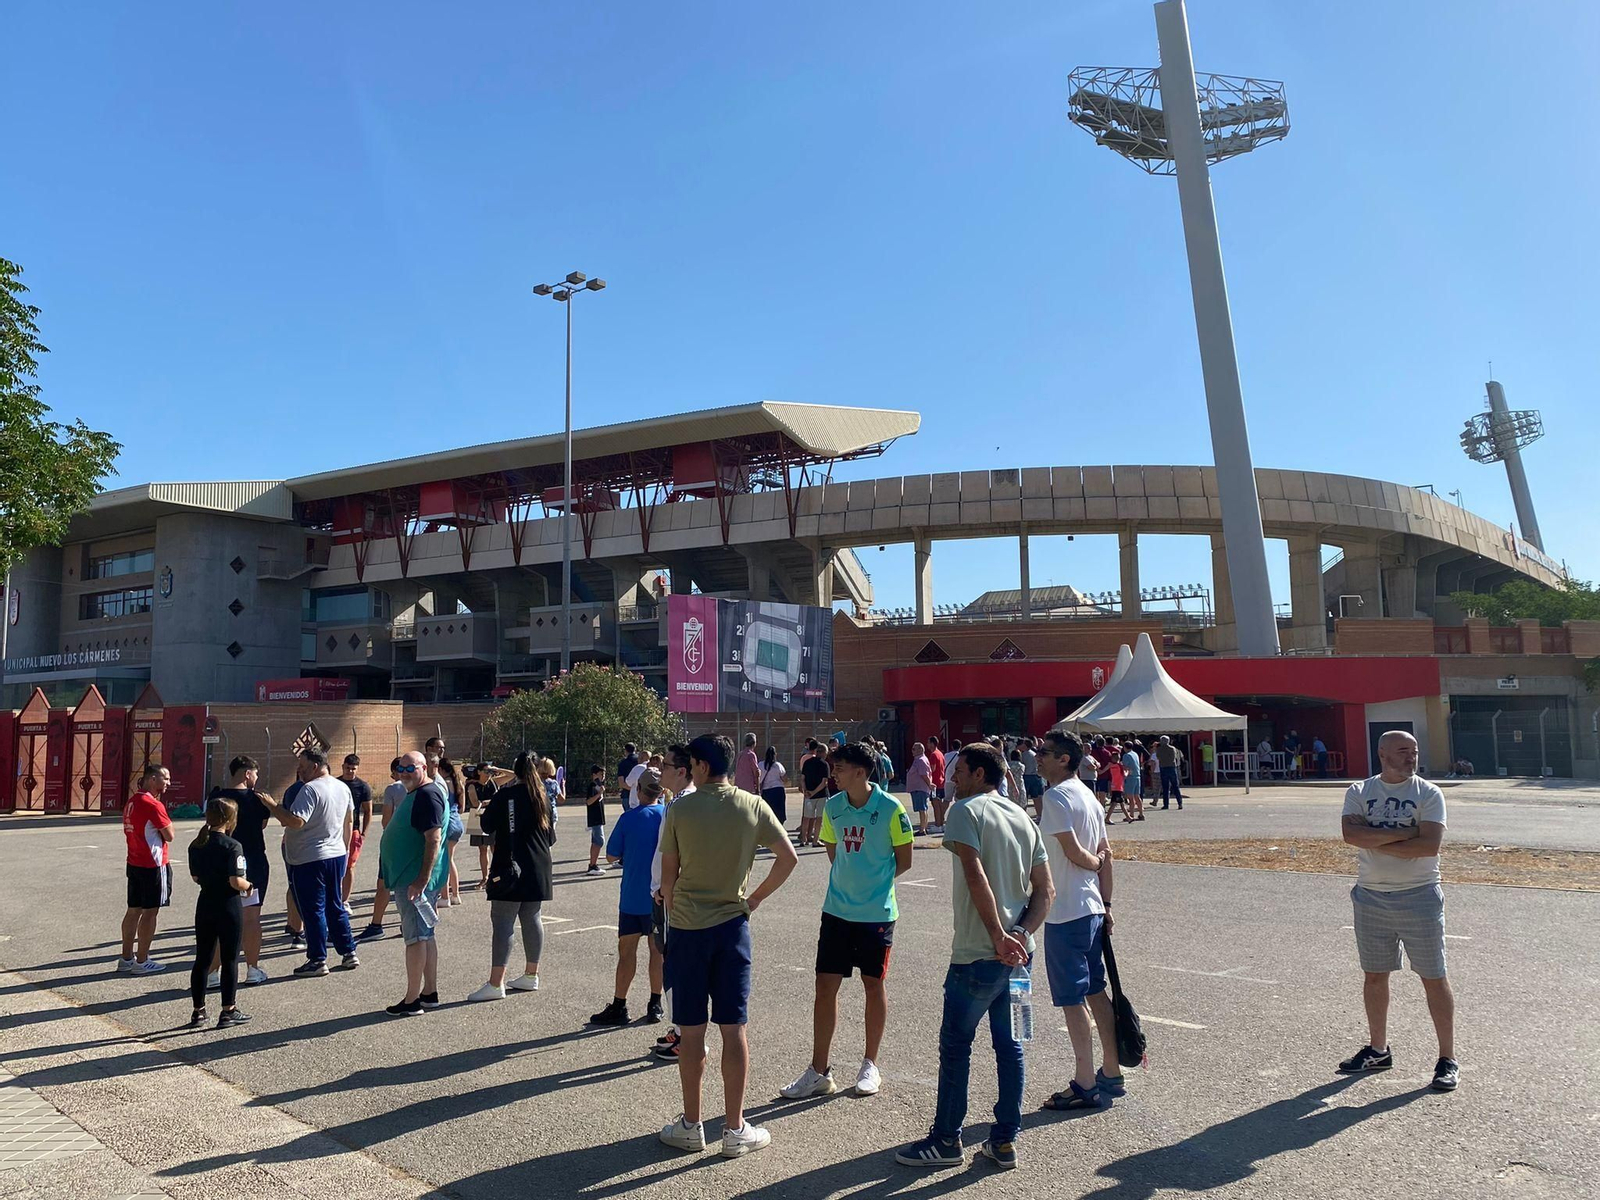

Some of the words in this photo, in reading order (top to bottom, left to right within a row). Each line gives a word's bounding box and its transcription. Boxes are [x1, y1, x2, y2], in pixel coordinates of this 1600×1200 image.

[736, 625, 743, 636] 2
[796, 625, 802, 636] 8
[40, 654, 62, 667] NUEVO
[63, 652, 77, 665] LOS
[79, 648, 120, 664] CÁRMENES
[731, 650, 738, 661] 3
[802, 647, 808, 657] 7
[799, 673, 805, 684] 6
[676, 682, 713, 691] BIENVENIDO
[742, 682, 748, 693] 4
[269, 690, 309, 700] BIENVENIDOS
[764, 689, 769, 699] 0
[782, 692, 788, 703] 5
